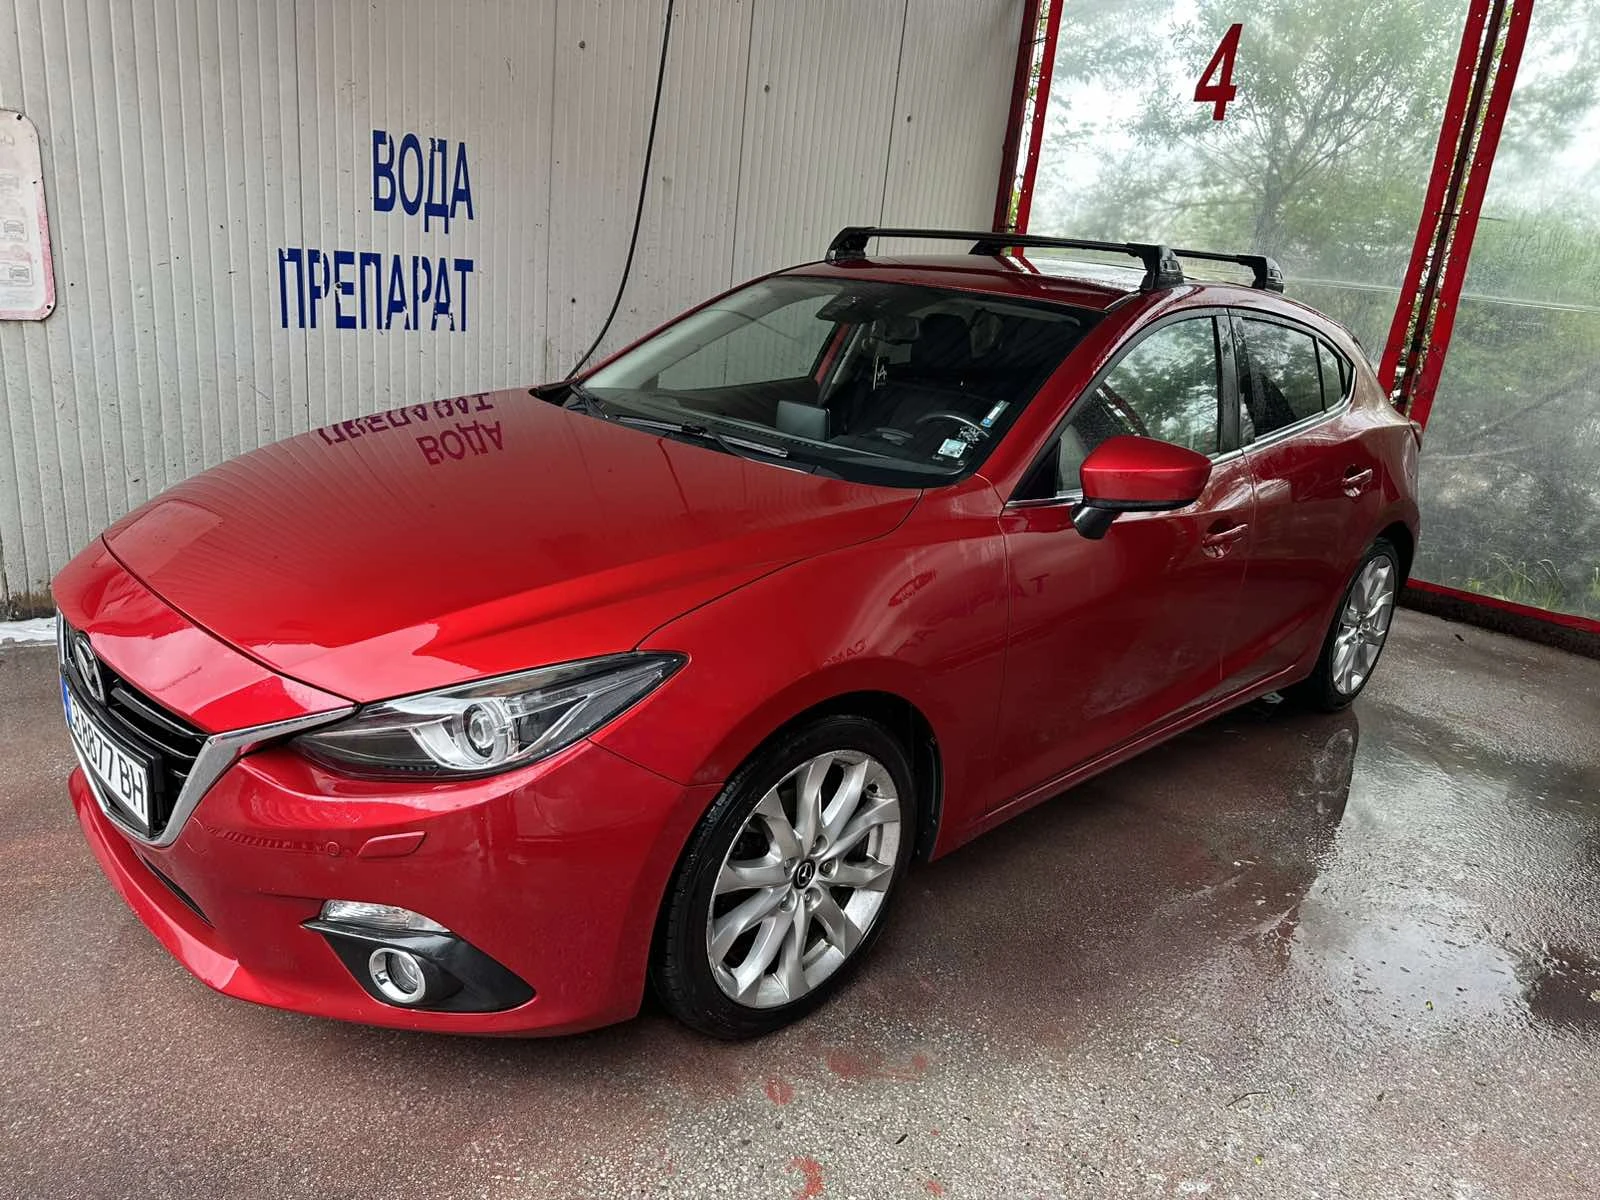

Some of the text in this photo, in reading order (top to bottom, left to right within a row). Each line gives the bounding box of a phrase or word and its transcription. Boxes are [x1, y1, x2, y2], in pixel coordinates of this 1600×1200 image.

[1194, 23, 1243, 121] 4
[372, 130, 474, 234] ВОДА
[278, 248, 474, 332] ПРЕПАРАТ
